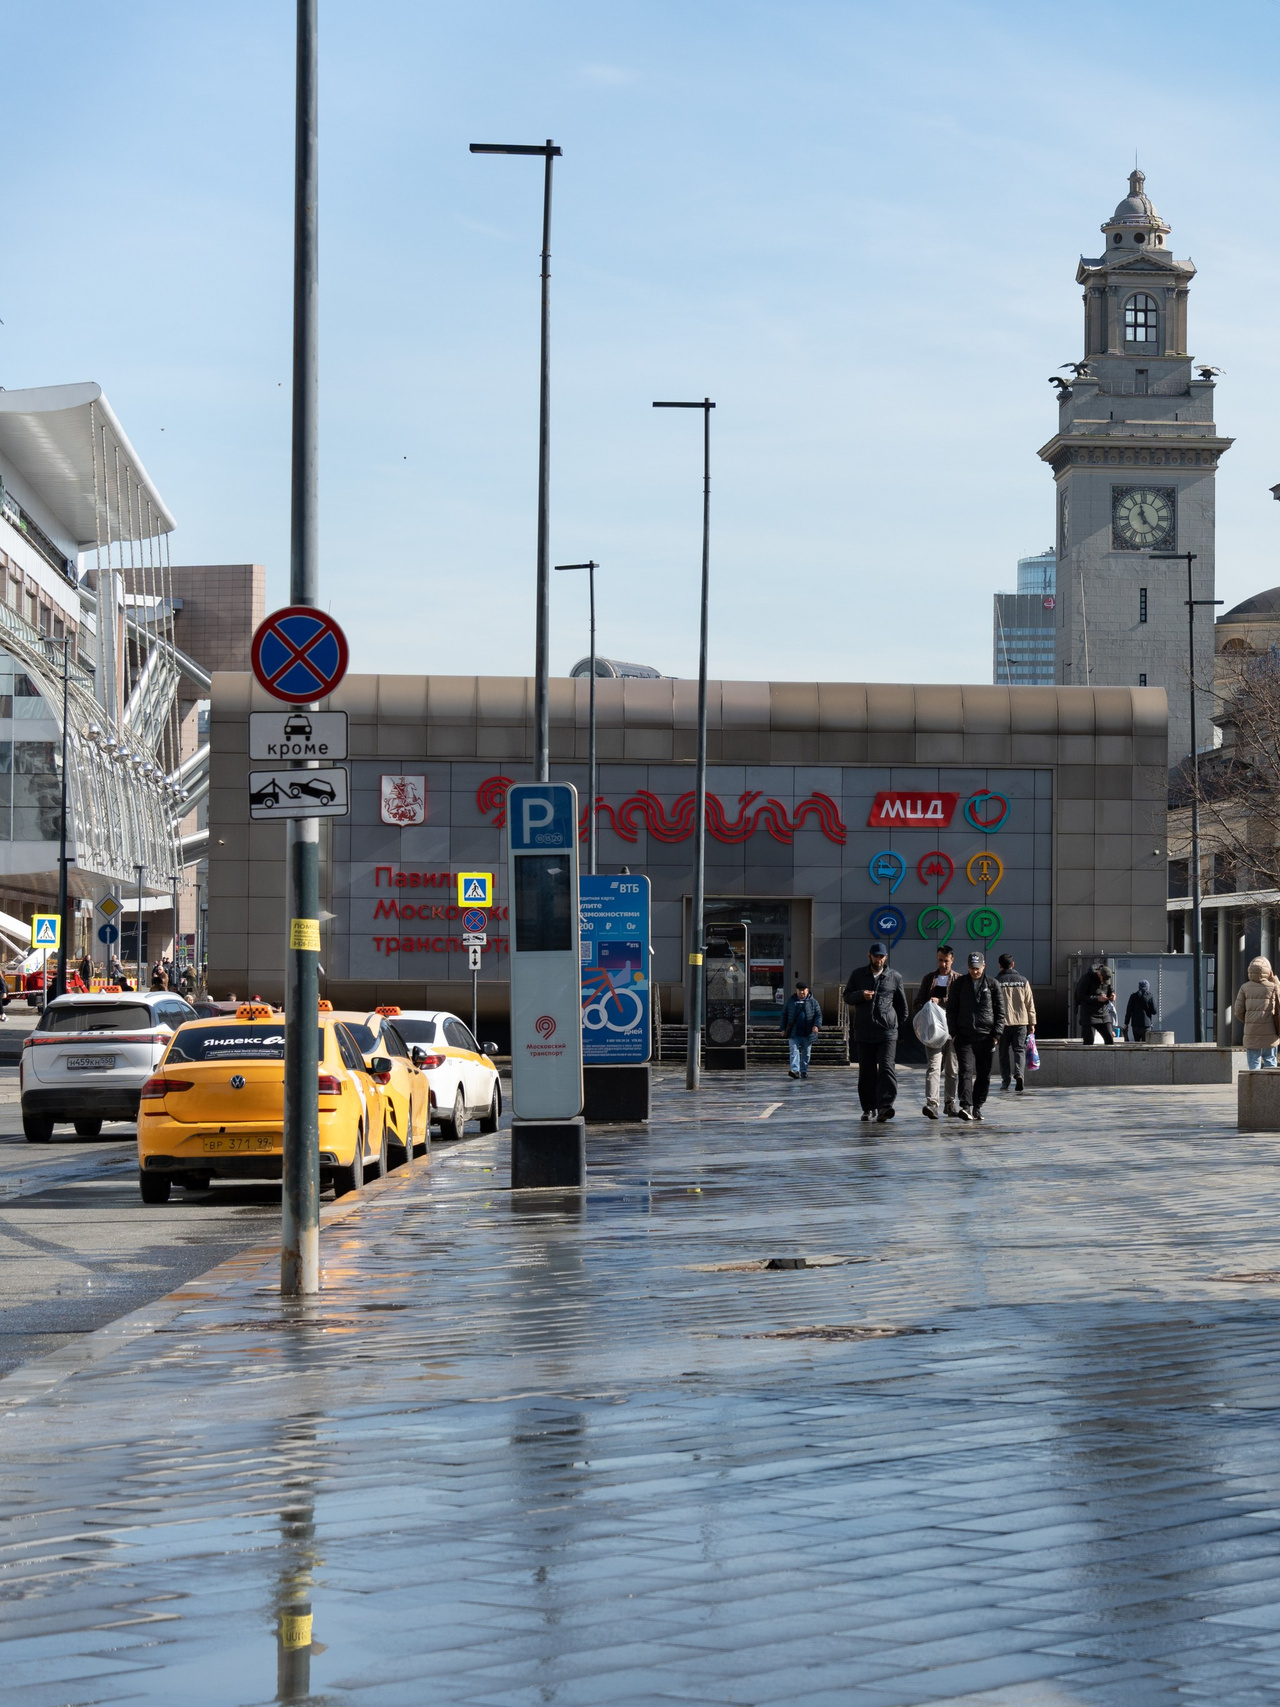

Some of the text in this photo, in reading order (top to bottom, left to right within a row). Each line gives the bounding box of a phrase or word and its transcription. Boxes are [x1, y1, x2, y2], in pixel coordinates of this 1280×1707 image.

[267, 743, 329, 759] кроме
[880, 799, 945, 819] МЦД
[522, 797, 555, 844] P
[375, 866, 496, 889] Павил
[619, 883, 640, 893] ВТБ
[624, 1028, 643, 1036] дней
[203, 1038, 262, 1047] Яндекс
[229, 1138, 251, 1149] 371
[257, 1137, 269, 1146] 99
